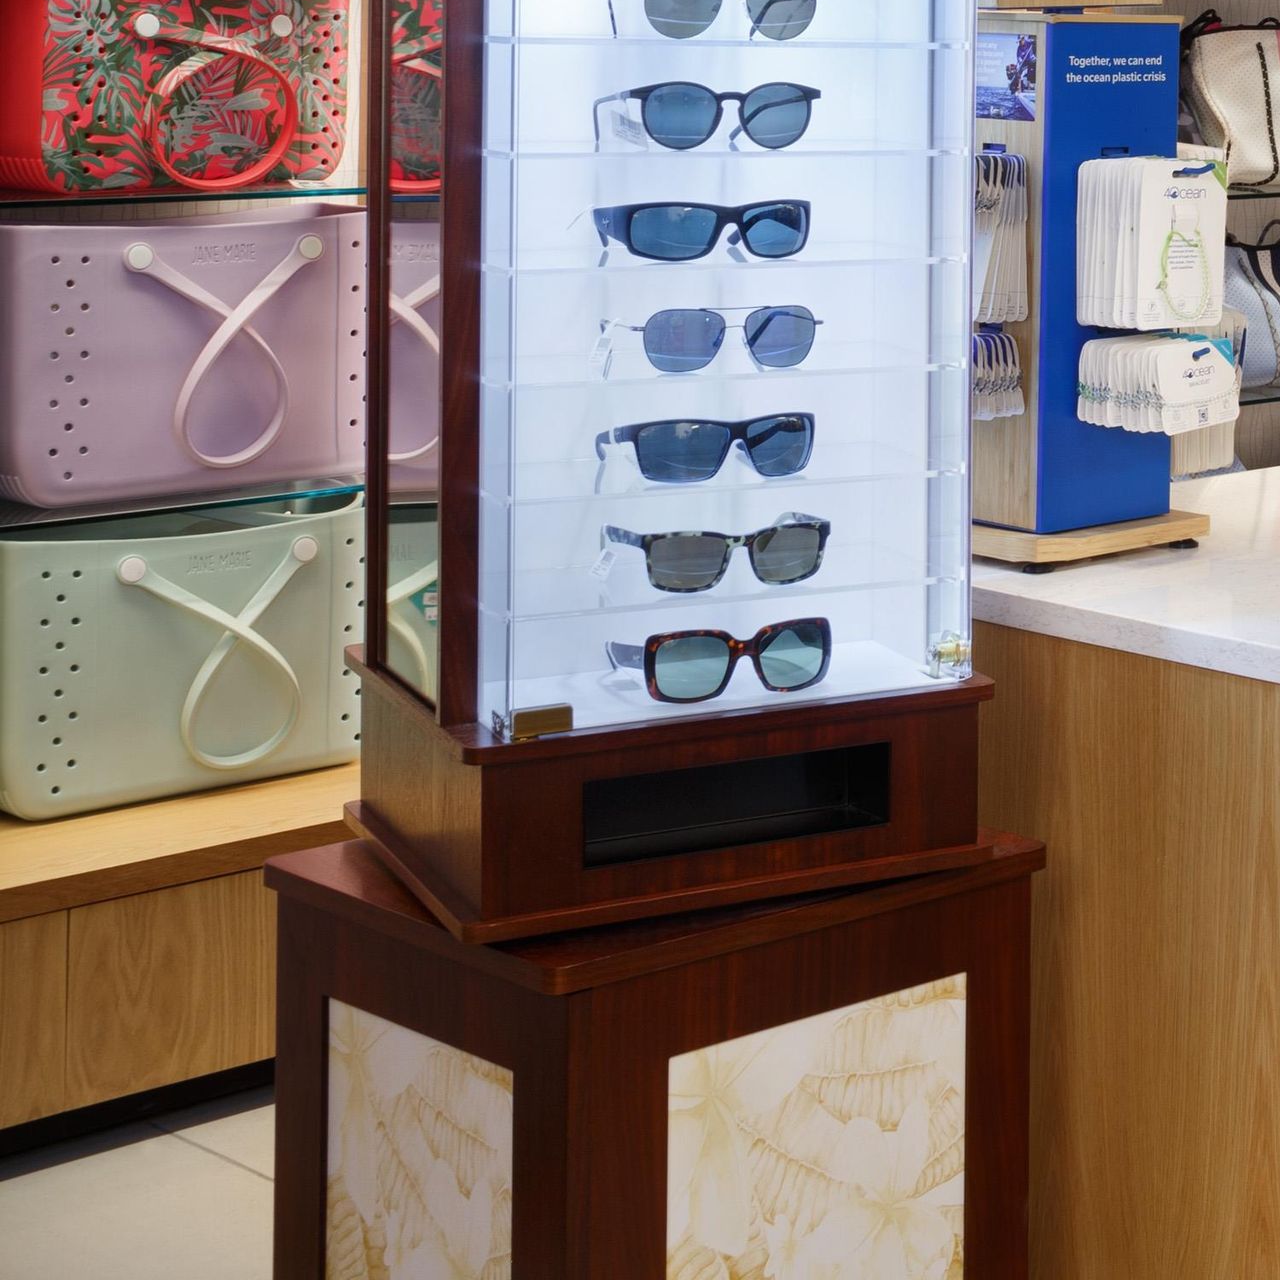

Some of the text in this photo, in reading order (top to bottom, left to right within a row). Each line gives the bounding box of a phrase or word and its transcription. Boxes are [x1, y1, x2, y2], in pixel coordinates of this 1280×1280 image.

[1068, 55, 1163, 68] Together, we can end
[1066, 70, 1167, 84] the ocean plastic crisis
[191, 242, 257, 265] JANE MARIE
[186, 554, 215, 576] JANE
